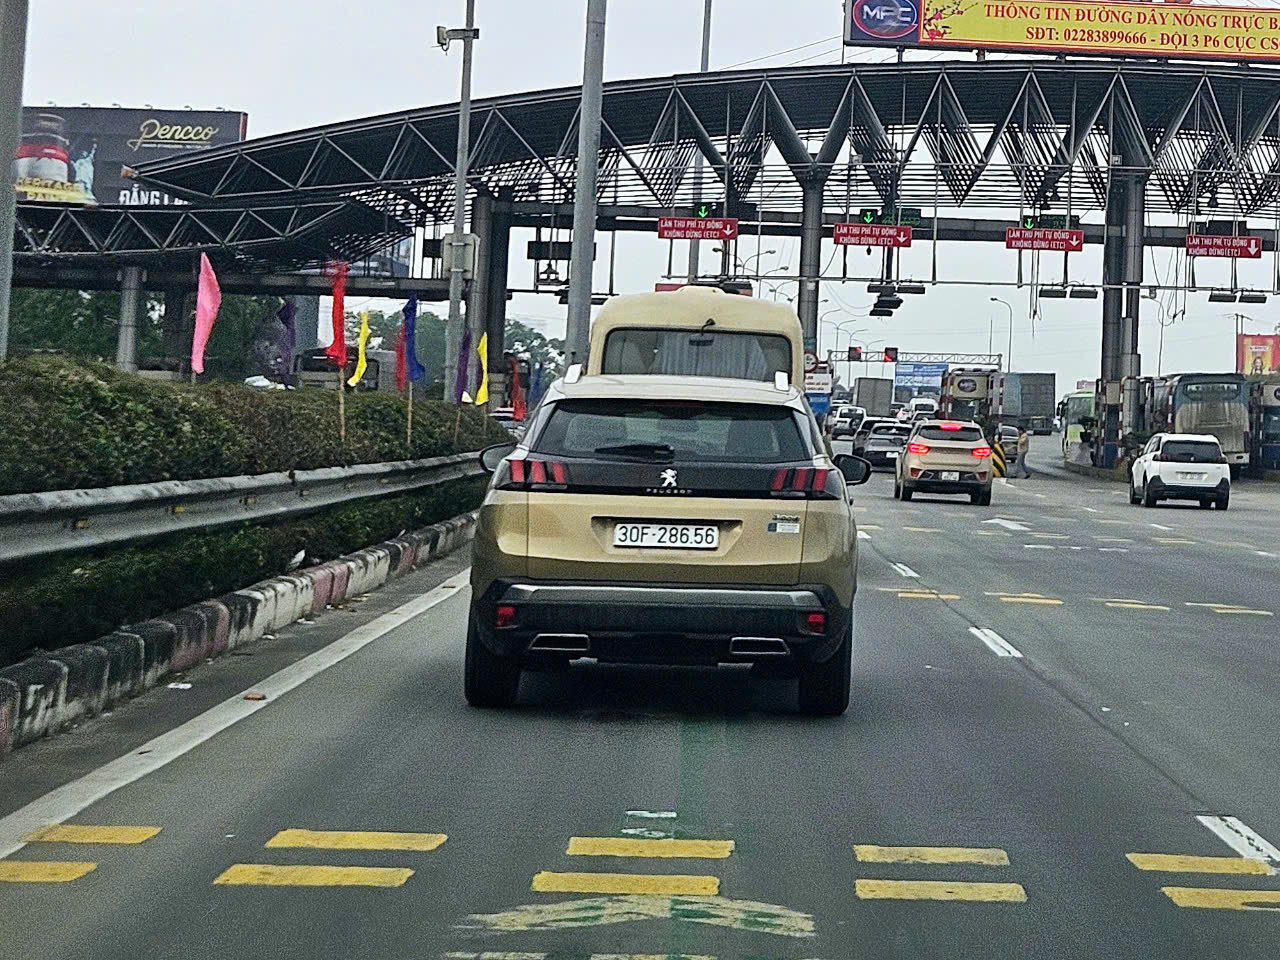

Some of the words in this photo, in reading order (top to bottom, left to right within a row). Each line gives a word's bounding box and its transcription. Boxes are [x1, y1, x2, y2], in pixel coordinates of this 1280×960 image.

[984, 2, 1040, 19] THÔNG
[1044, 6, 1071, 21] TIN
[1075, 6, 1132, 24] ĐƯỜNG
[1137, 8, 1169, 26] DÂY
[1172, 9, 1217, 27] NÓNG
[1222, 14, 1265, 32] TRỰC
[1026, 26, 1059, 41] SĐT:
[1063, 28, 1147, 45] 02283899666
[1159, 31, 1188, 50] ĐỘI
[1192, 34, 1199, 46] 3
[1203, 34, 1220, 48] P6
[1224, 35, 1256, 52] CỤC
[128, 119, 219, 151] Pencco
[837, 225, 847, 233] LÀN
[861, 226, 871, 234] PHÍ
[1009, 229, 1020, 237] LÀN
[1189, 237, 1199, 245] LÀN
[1213, 237, 1222, 245] PHÍ
[618, 526, 715, 544] 30F-286.56
